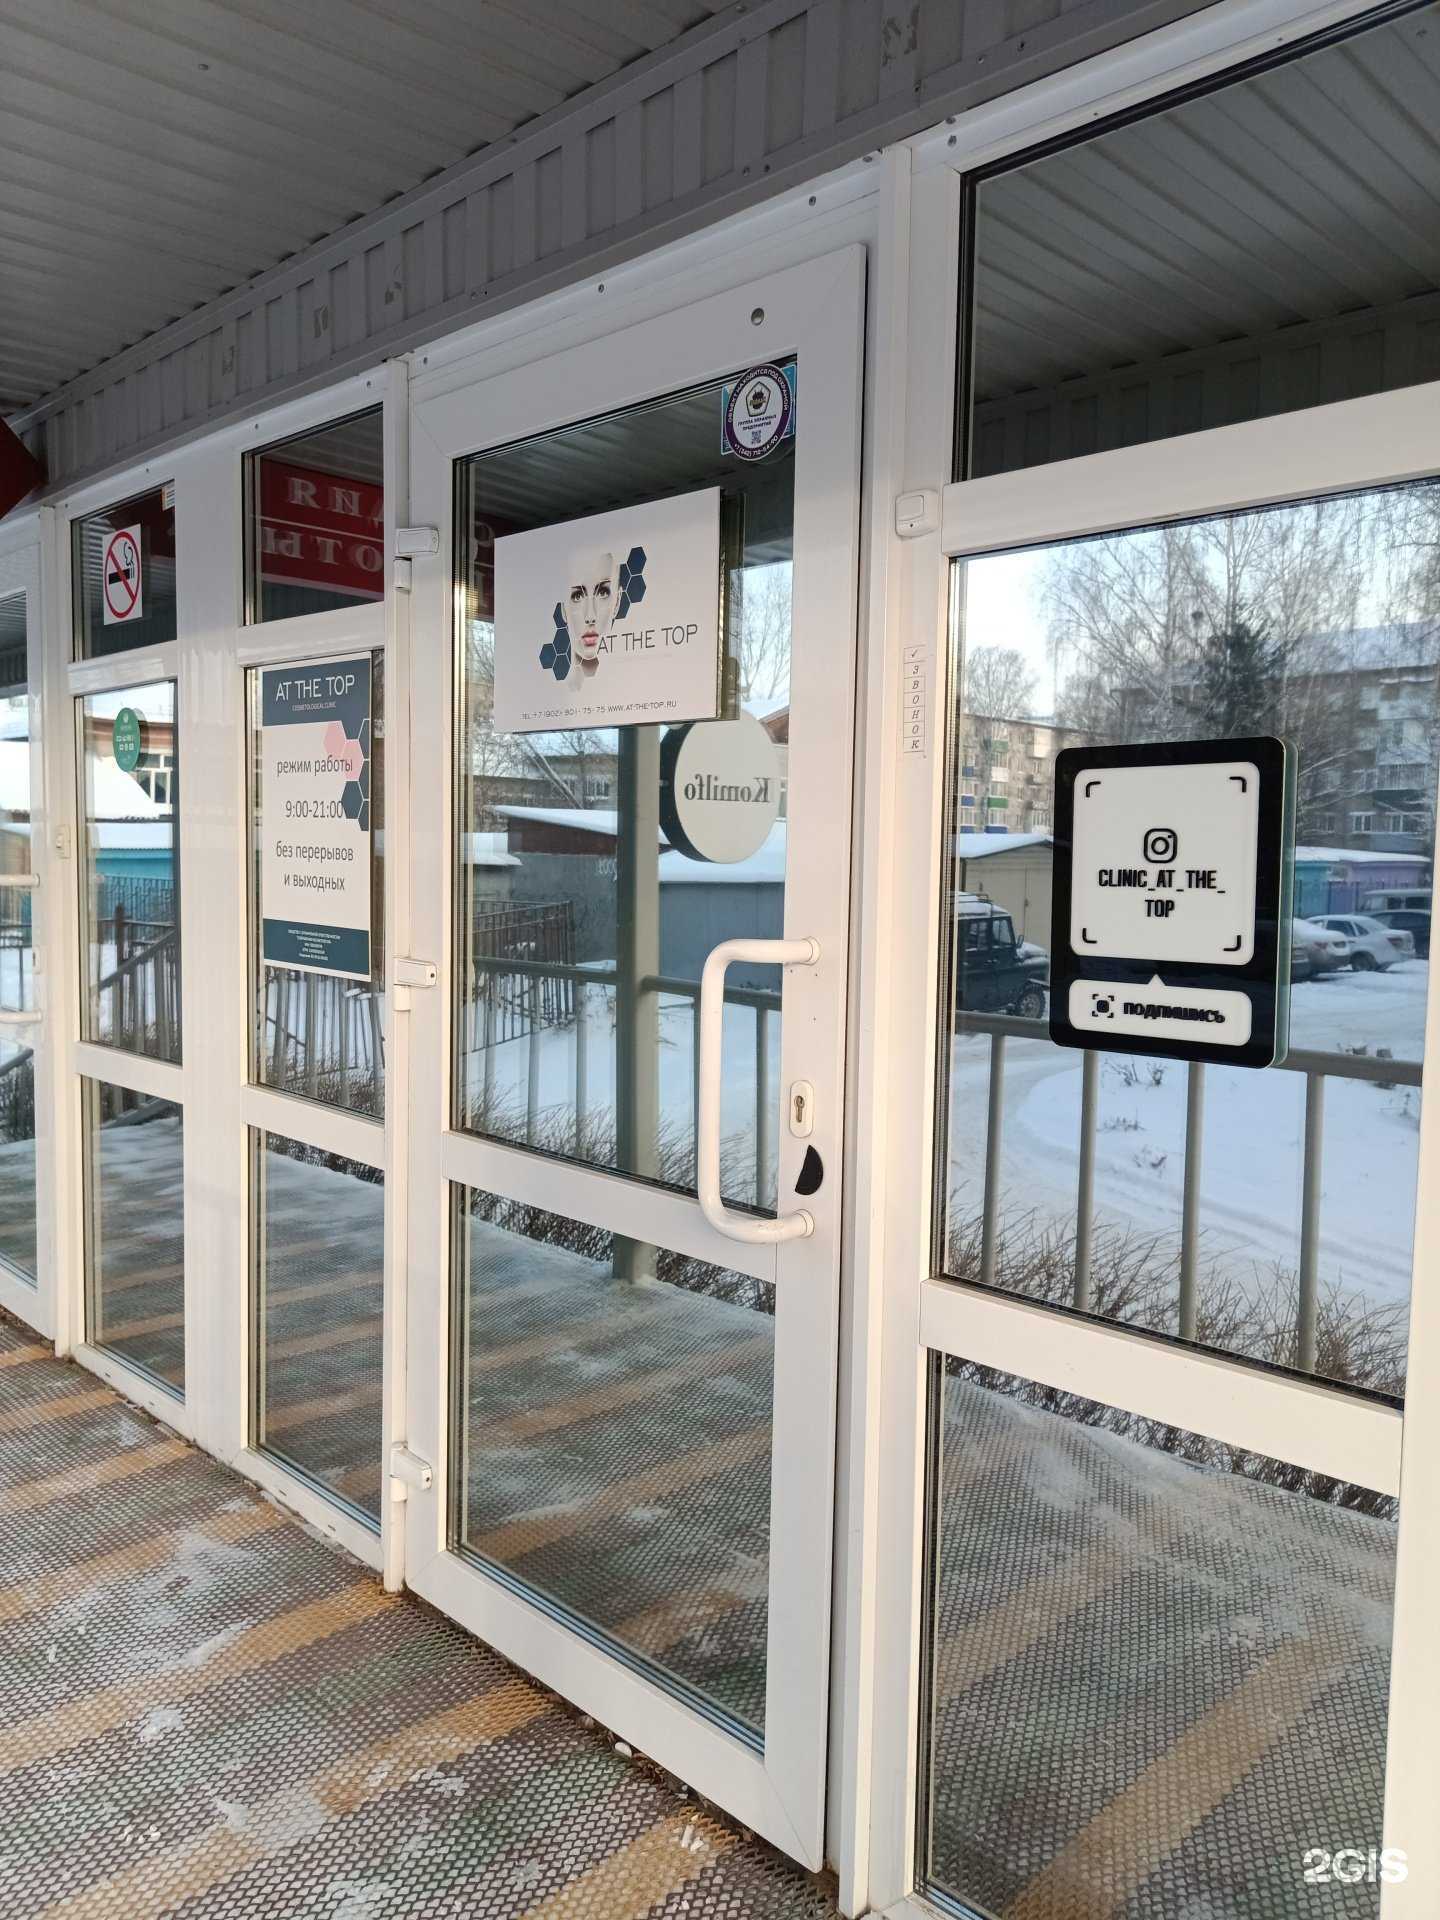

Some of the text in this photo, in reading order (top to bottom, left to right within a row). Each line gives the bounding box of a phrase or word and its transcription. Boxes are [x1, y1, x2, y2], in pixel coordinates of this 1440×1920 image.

[597, 624, 698, 655] AT THE TOP
[276, 674, 355, 701] AT THE TOP
[911, 665, 920, 749] ЗВОНОК
[277, 754, 353, 777] режим работы
[285, 800, 344, 818] 9:00-21:00
[276, 841, 354, 863] без перерывов
[284, 873, 345, 893] и выходных
[1099, 869, 1226, 894] CLINIC_AT_THE_
[1145, 900, 1175, 918] TOP
[1123, 1002, 1226, 1024] подпишись
